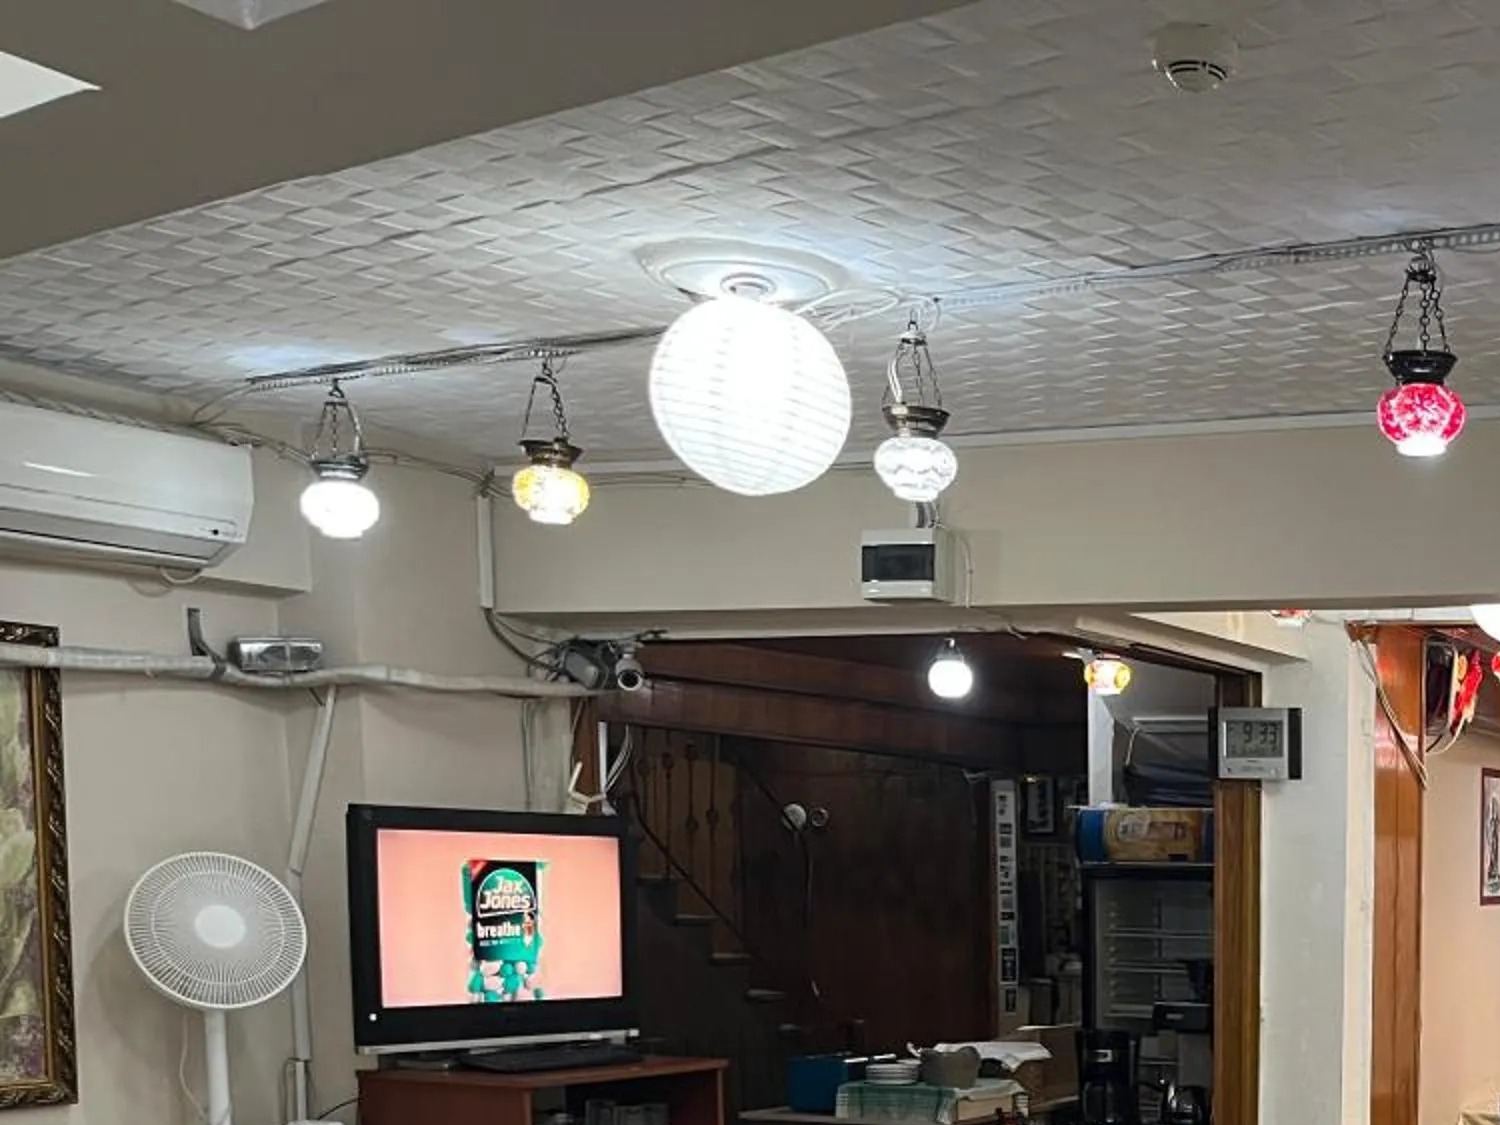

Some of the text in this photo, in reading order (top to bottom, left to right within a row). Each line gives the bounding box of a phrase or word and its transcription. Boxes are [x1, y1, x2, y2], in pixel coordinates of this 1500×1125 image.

[494, 875, 523, 894] Jax
[480, 891, 531, 909] Jones
[476, 920, 521, 938] breathe
